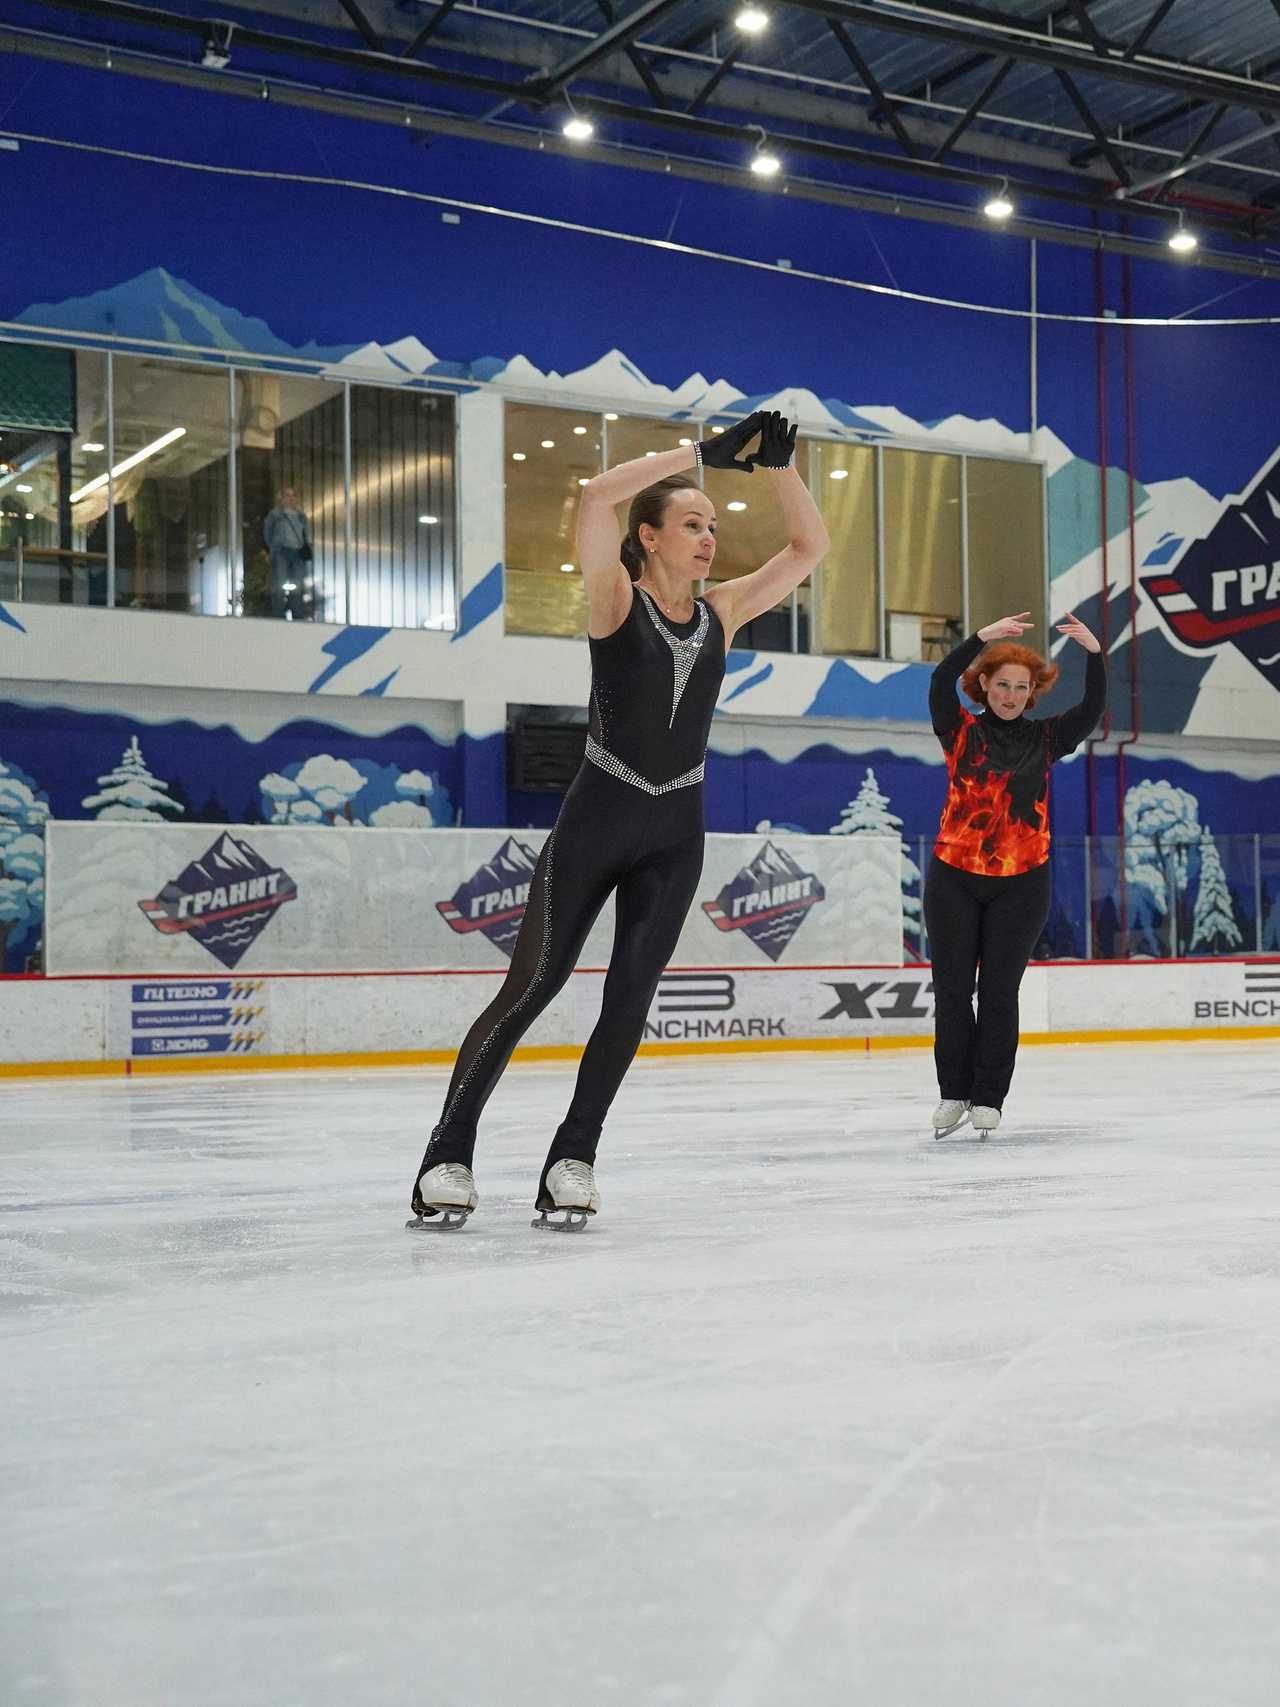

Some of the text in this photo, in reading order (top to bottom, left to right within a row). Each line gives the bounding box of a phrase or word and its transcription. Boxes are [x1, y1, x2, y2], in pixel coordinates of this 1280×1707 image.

[177, 872, 281, 920] ГРАНИТ
[470, 882, 531, 919] ГРАН
[732, 876, 813, 918] ГРАНИТ
[166, 985, 218, 999] ТЕХНО
[817, 982, 934, 1020] X1
[644, 1017, 786, 1038] NCHMARK
